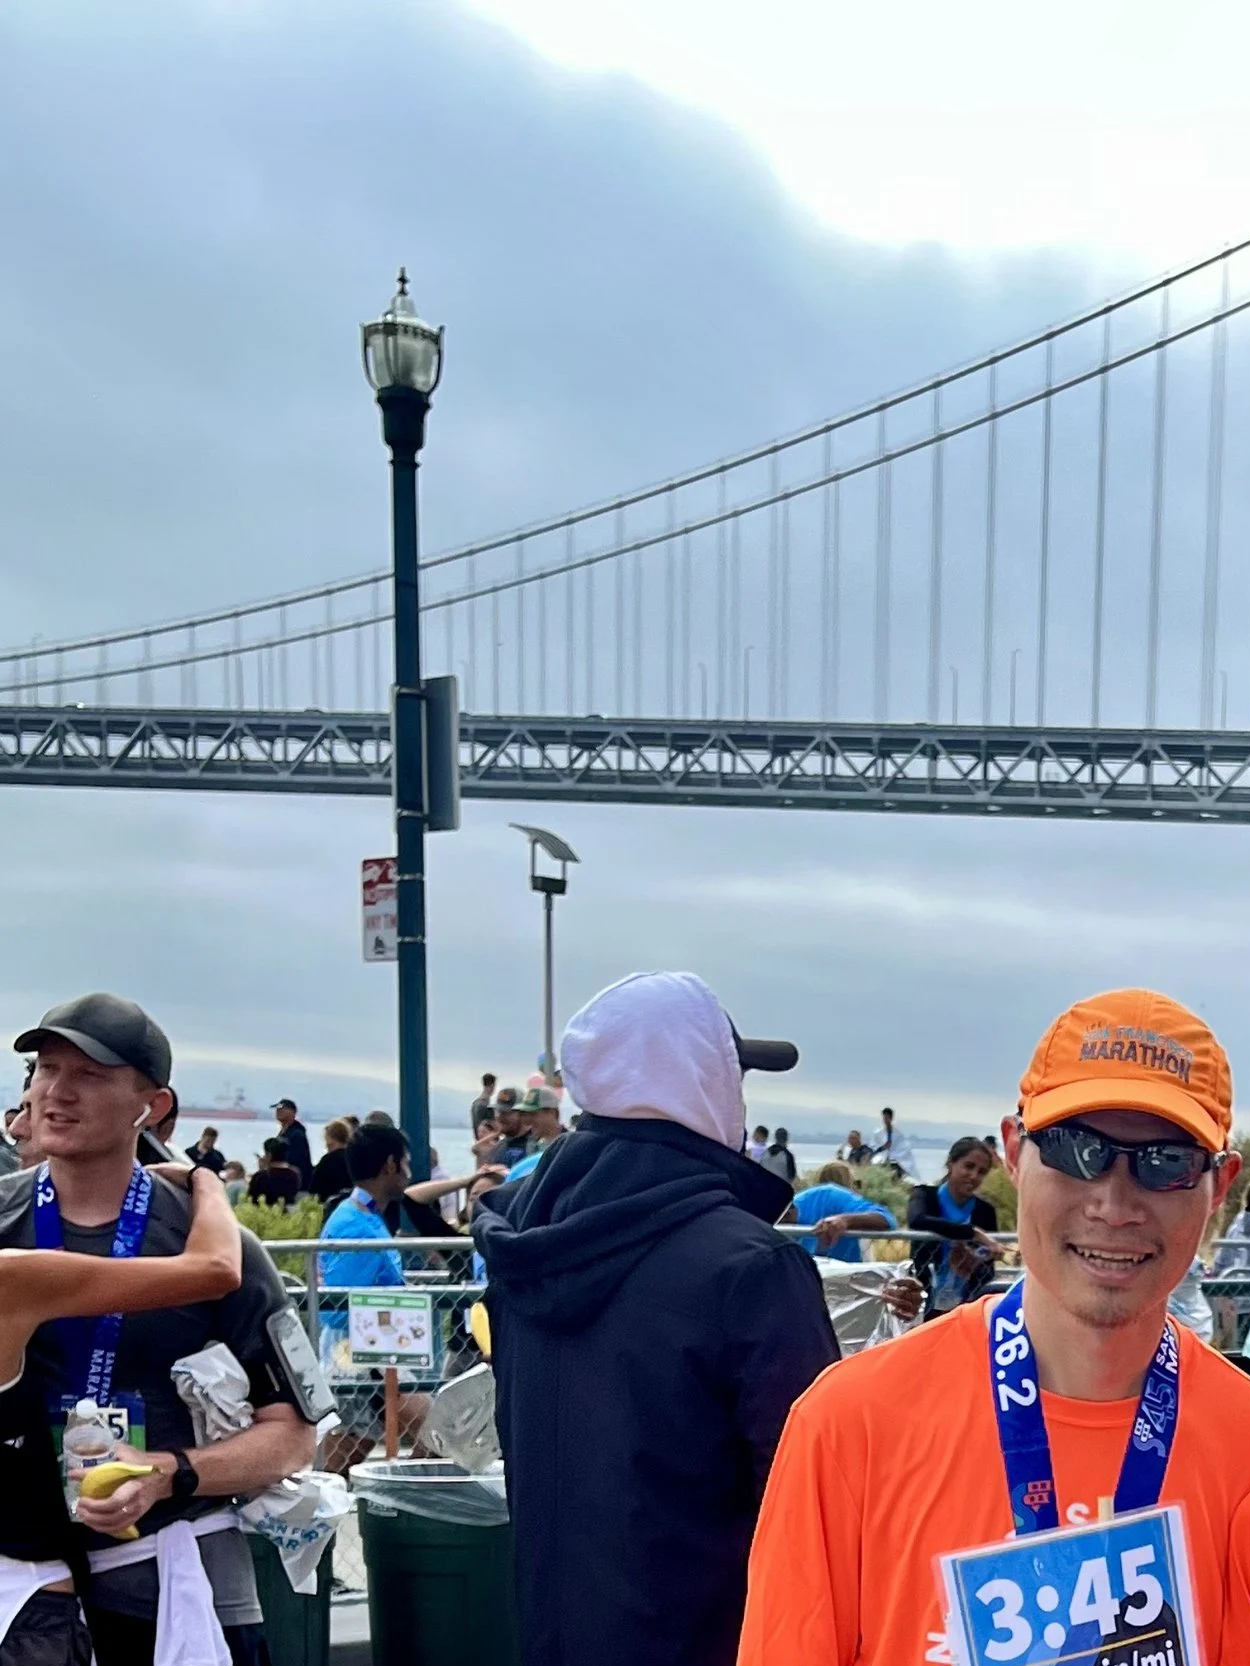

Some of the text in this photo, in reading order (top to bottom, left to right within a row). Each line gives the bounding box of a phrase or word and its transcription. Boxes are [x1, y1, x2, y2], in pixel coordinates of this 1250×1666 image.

[1078, 1040, 1192, 1085] MARATHON
[995, 1307, 1037, 1411] 26.2
[975, 1544, 1164, 1661] 3:45
